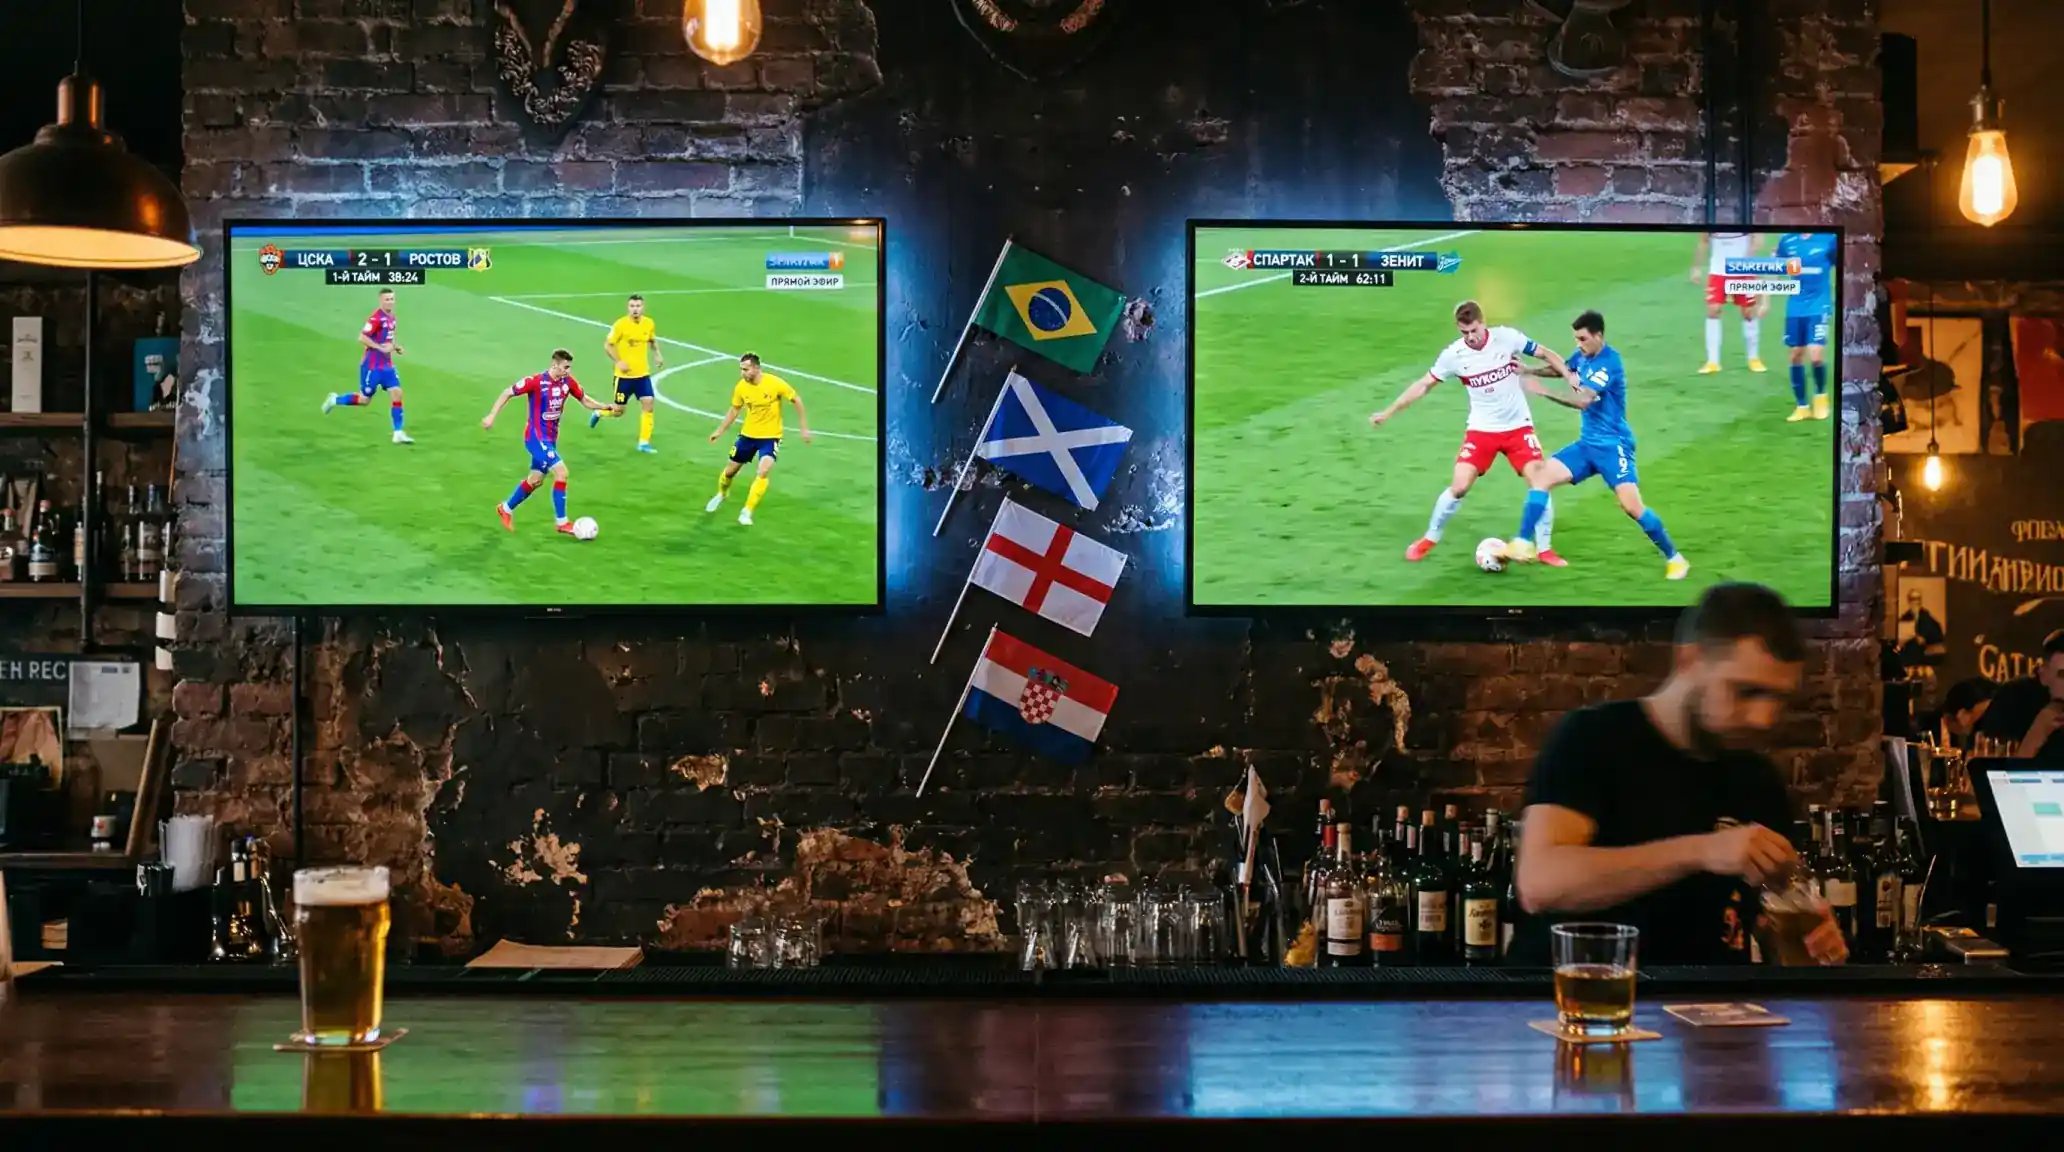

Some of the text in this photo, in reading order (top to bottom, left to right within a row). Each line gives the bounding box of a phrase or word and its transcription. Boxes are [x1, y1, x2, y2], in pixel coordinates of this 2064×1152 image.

[297, 253, 334, 267] ЦСКА
[358, 253, 367, 266] 2
[384, 253, 391, 266] 1
[409, 253, 461, 265] РОСТОВ
[1253, 253, 1315, 266] СПАРТАК
[1327, 254, 1333, 266] 1
[1352, 254, 1358, 266] 1
[1380, 254, 1424, 267] ЗЕНИТ
[1789, 260, 1797, 273] 1
[352, 271, 380, 282] ТАЙМ
[388, 272, 418, 282] 38:24
[771, 276, 839, 286] ПРЯМОЙ ЭФИР
[1299, 271, 1386, 284] 2-Й ТАЙМ 62:11
[1729, 280, 1796, 291] ПРЯМОЙ ЭФИР
